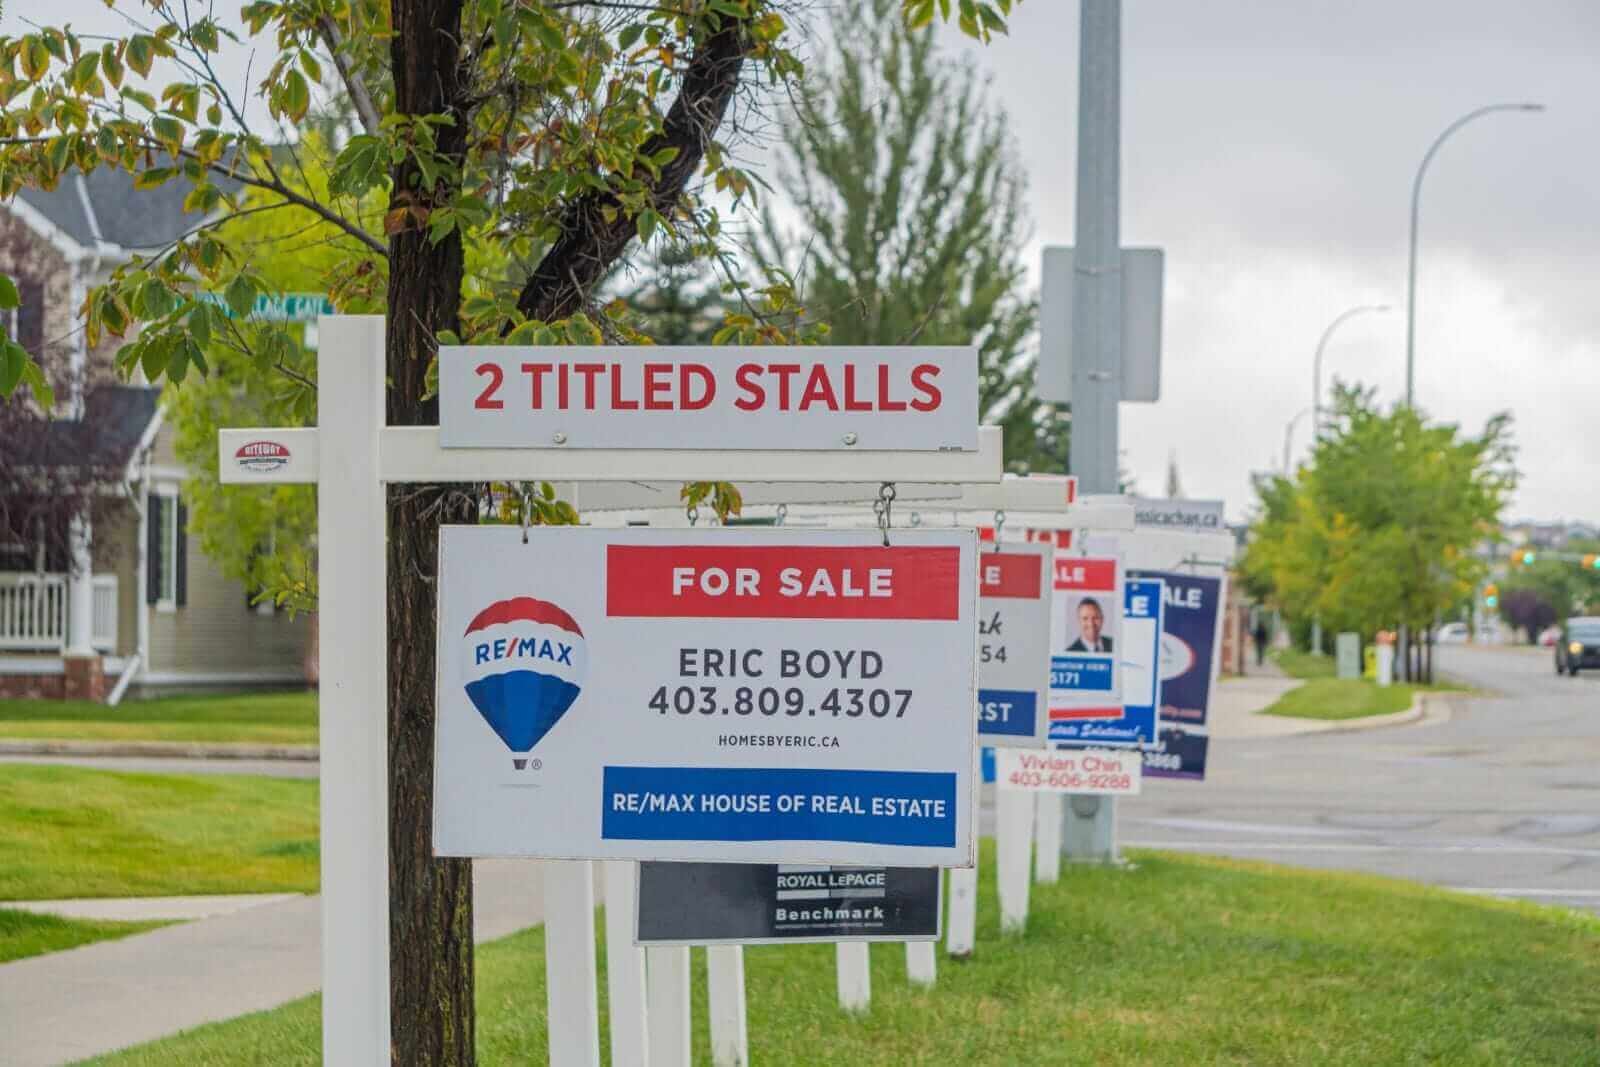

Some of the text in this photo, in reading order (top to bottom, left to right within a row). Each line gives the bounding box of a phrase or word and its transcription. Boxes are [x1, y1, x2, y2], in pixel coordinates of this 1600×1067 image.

[474, 362, 942, 412] 2 TITLED STALLS
[672, 567, 894, 598] FOR SALE
[1056, 567, 1086, 583] LE
[1123, 596, 1149, 616] E
[475, 637, 573, 666] RE/MAX
[679, 648, 883, 679] ERIC BOYD
[648, 685, 913, 718] 403.809.4307
[718, 734, 840, 748] HOMESBYERIC.CA
[612, 792, 946, 818] RE/MAX HOUSE OF REAL ESTATE
[776, 874, 827, 888] ROYAL
[775, 906, 884, 921] Benchmark
